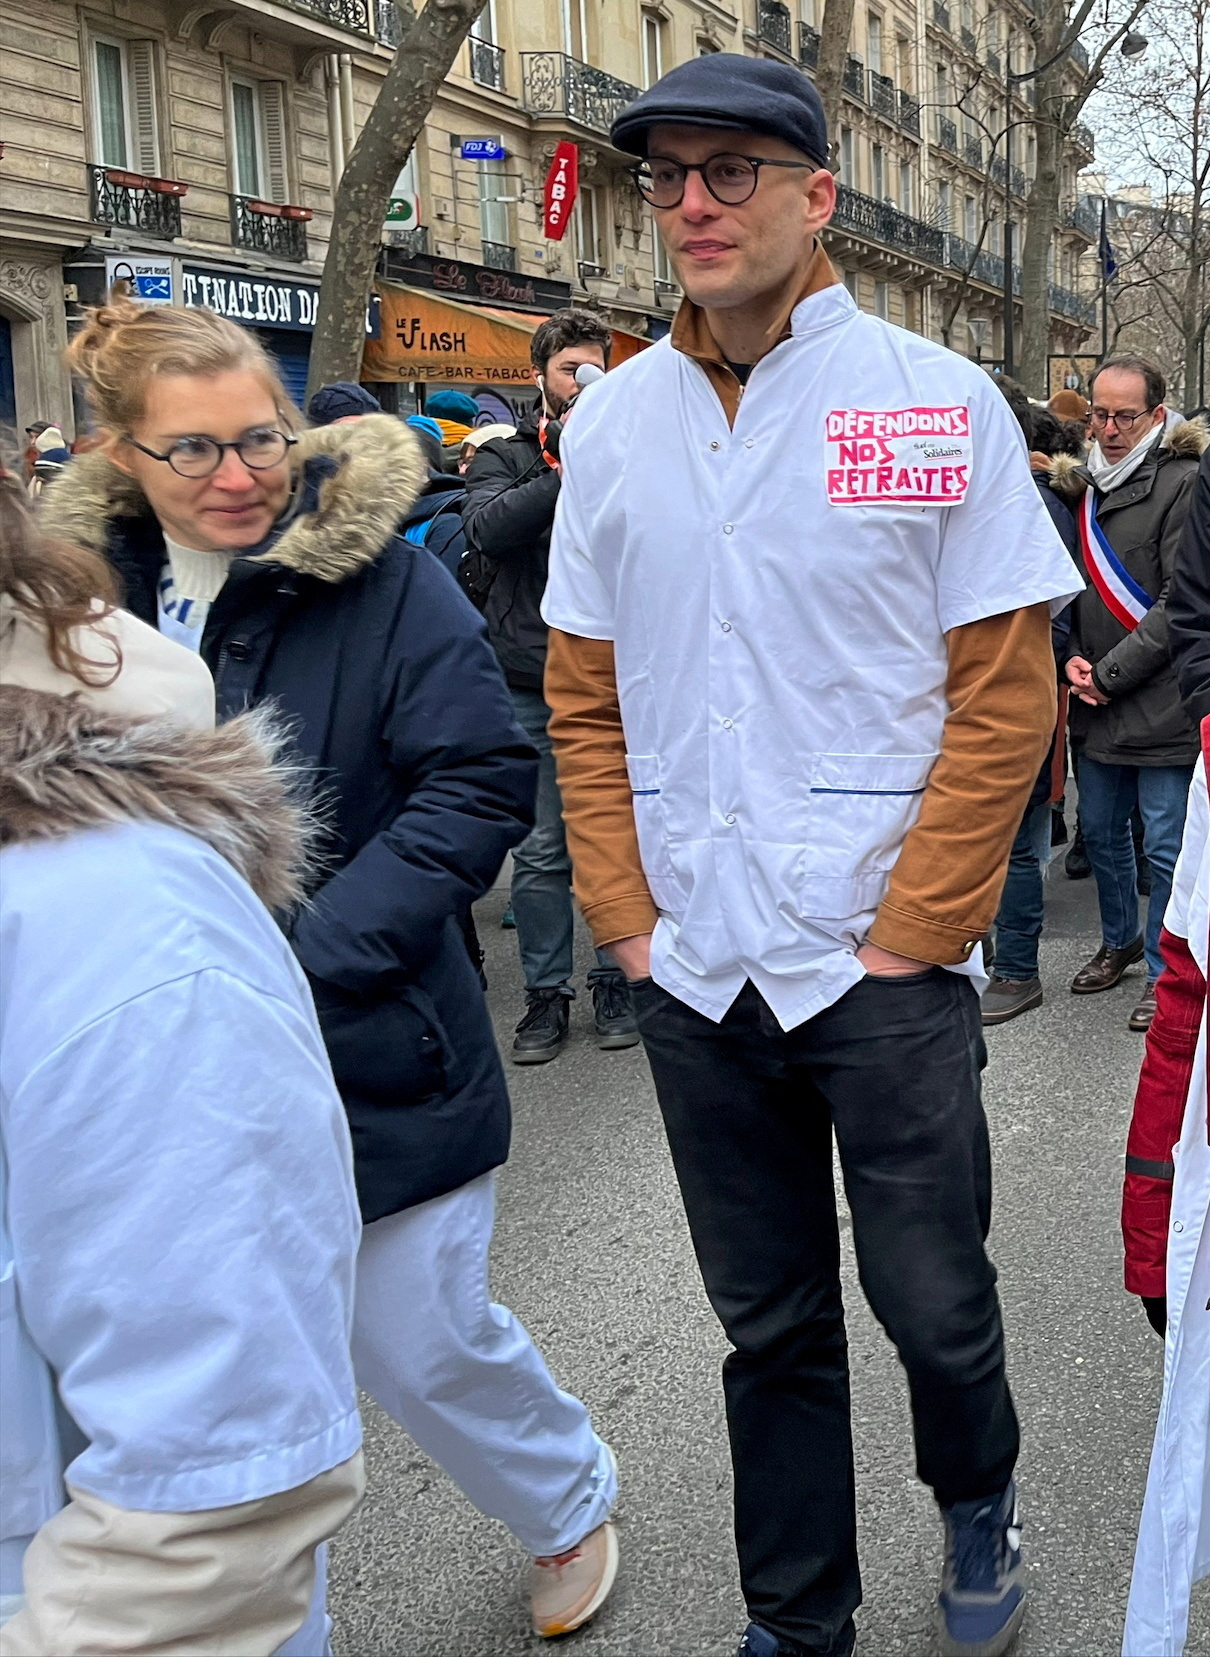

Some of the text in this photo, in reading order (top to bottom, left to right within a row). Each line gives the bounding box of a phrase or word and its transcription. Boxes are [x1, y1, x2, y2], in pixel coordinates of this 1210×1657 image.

[465, 142, 482, 151] FDJ
[549, 157, 569, 225] TABAC
[182, 272, 292, 323] TINATION
[396, 318, 406, 329] LE
[828, 408, 968, 437] DÉFENDONS
[839, 438, 896, 466] NOS
[923, 447, 963, 459] Solidaires
